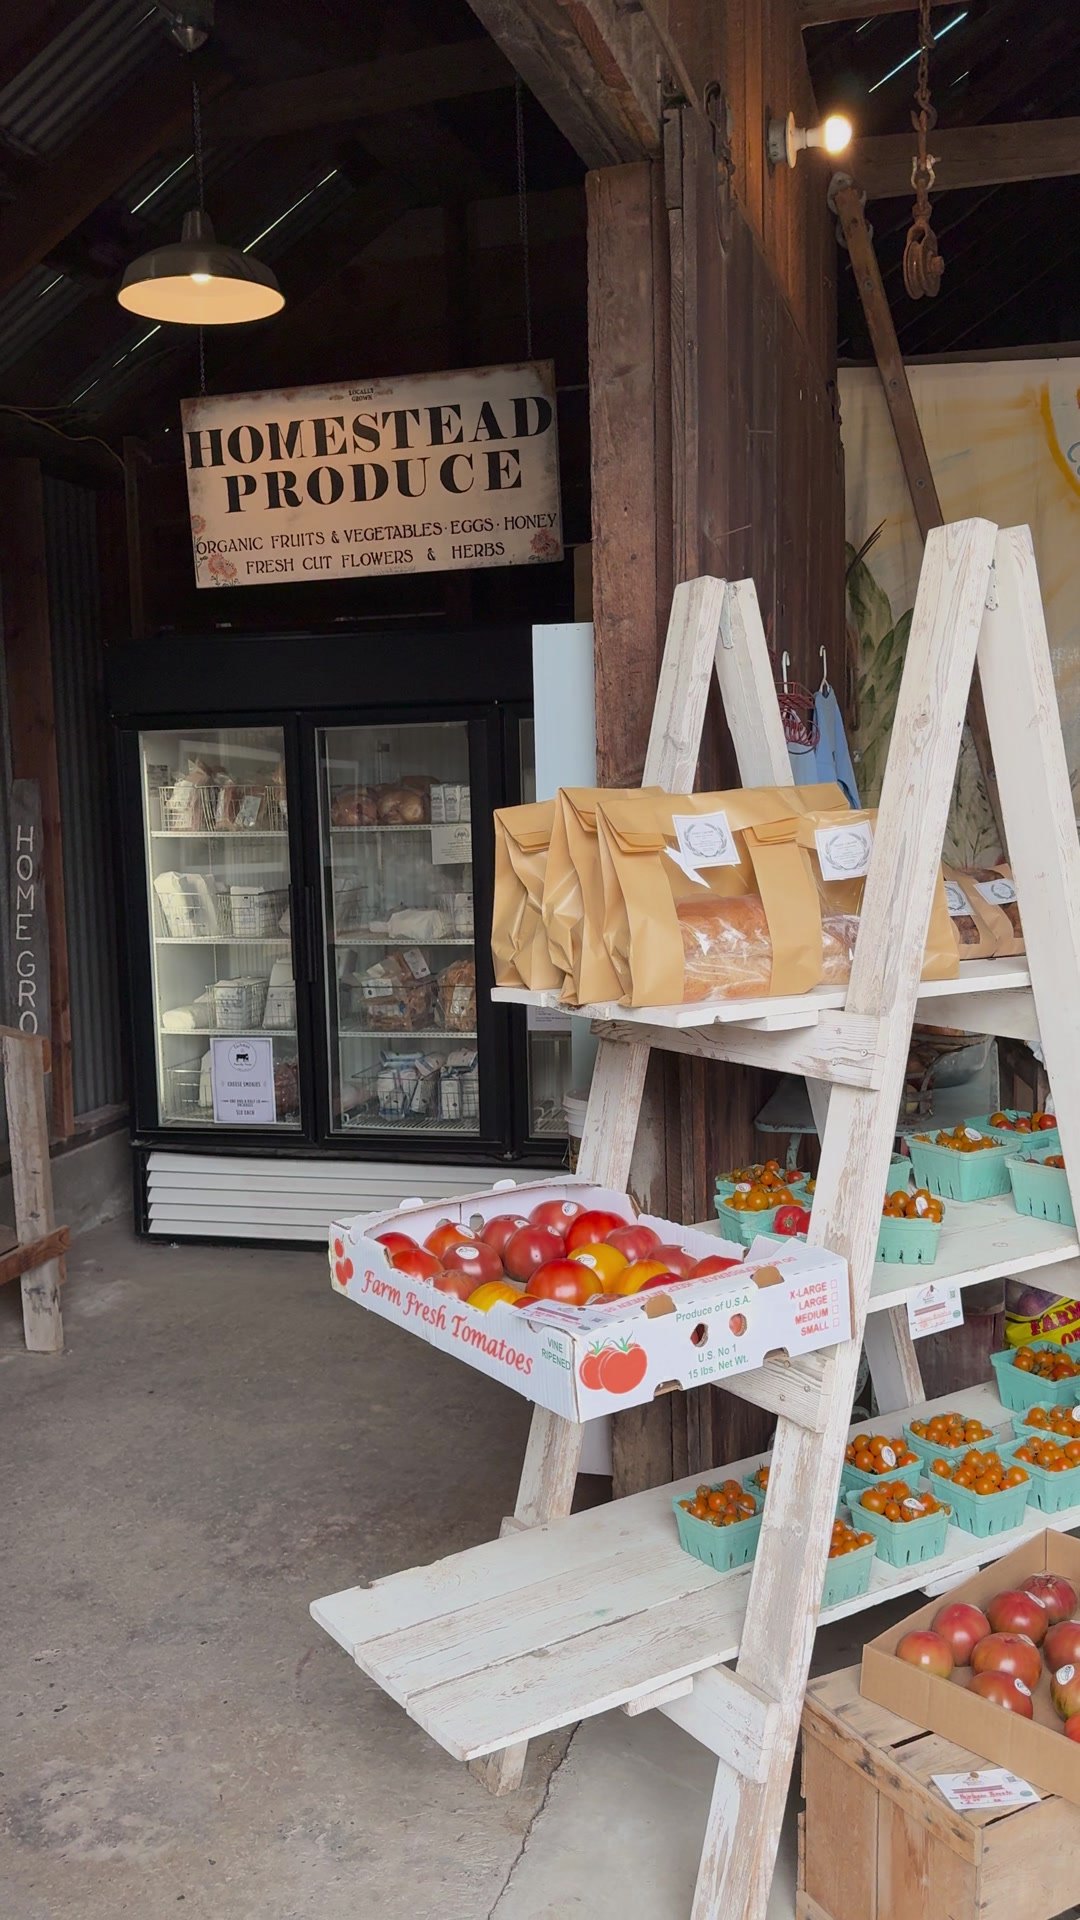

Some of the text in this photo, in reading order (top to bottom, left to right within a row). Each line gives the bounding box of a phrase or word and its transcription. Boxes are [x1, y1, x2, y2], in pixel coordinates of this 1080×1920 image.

[348, 387, 374, 396] LOCALLY
[351, 394, 373, 402] GROWN
[187, 396, 553, 469] HOMESTEAD
[222, 449, 522, 513] PRODUCE
[196, 537, 263, 555] ORGANIC
[271, 531, 325, 549] FRUITS
[331, 530, 340, 545] &
[450, 518, 494, 535] EGGS
[504, 512, 557, 531] HONEY
[246, 542, 505, 575] FRESH CUT FLOWERS & HERBS
[790, 1281, 828, 1300] X-LARGE
[676, 1295, 751, 1322] Produce of U.S.A.
[799, 1295, 828, 1310] LARGE
[361, 1270, 533, 1376] Farm Fresh Tomatoes
[794, 1308, 829, 1325] MEDIUM
[801, 1322, 829, 1337] SMALL
[547, 1337, 563, 1353] VINE
[697, 1343, 737, 1363] U.S. No 1
[541, 1348, 571, 1370] RIPENED
[688, 1354, 749, 1380] 15 lbs. Net Wt.
